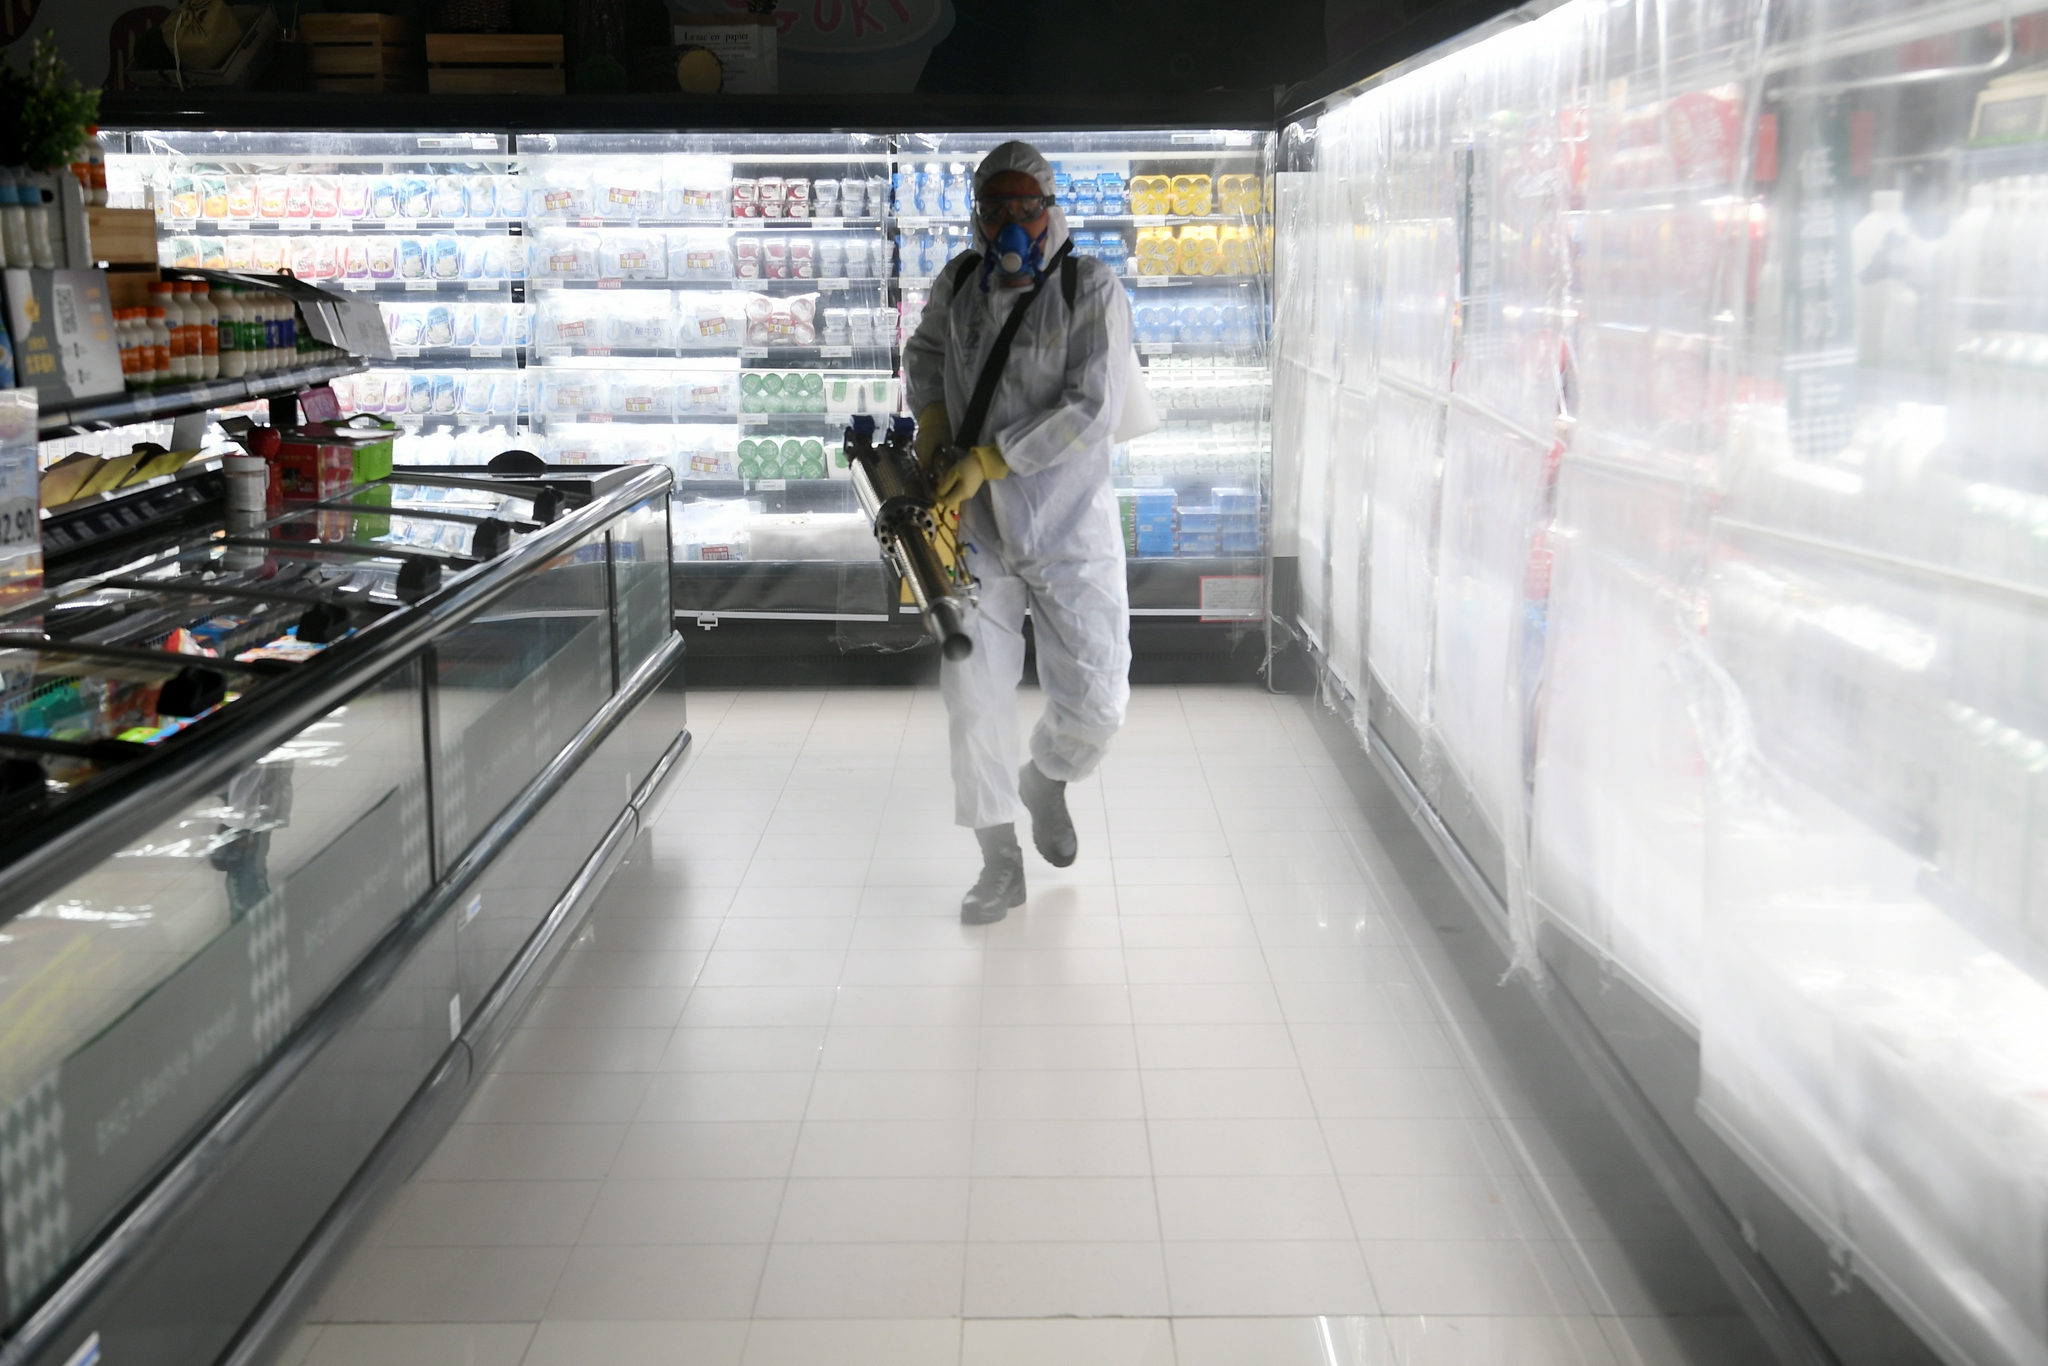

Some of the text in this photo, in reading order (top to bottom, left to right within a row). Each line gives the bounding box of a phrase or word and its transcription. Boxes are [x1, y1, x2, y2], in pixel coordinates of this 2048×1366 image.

[684, 32, 694, 41] Le
[725, 32, 749, 43] papier
[0, 508, 34, 544] 2.90
